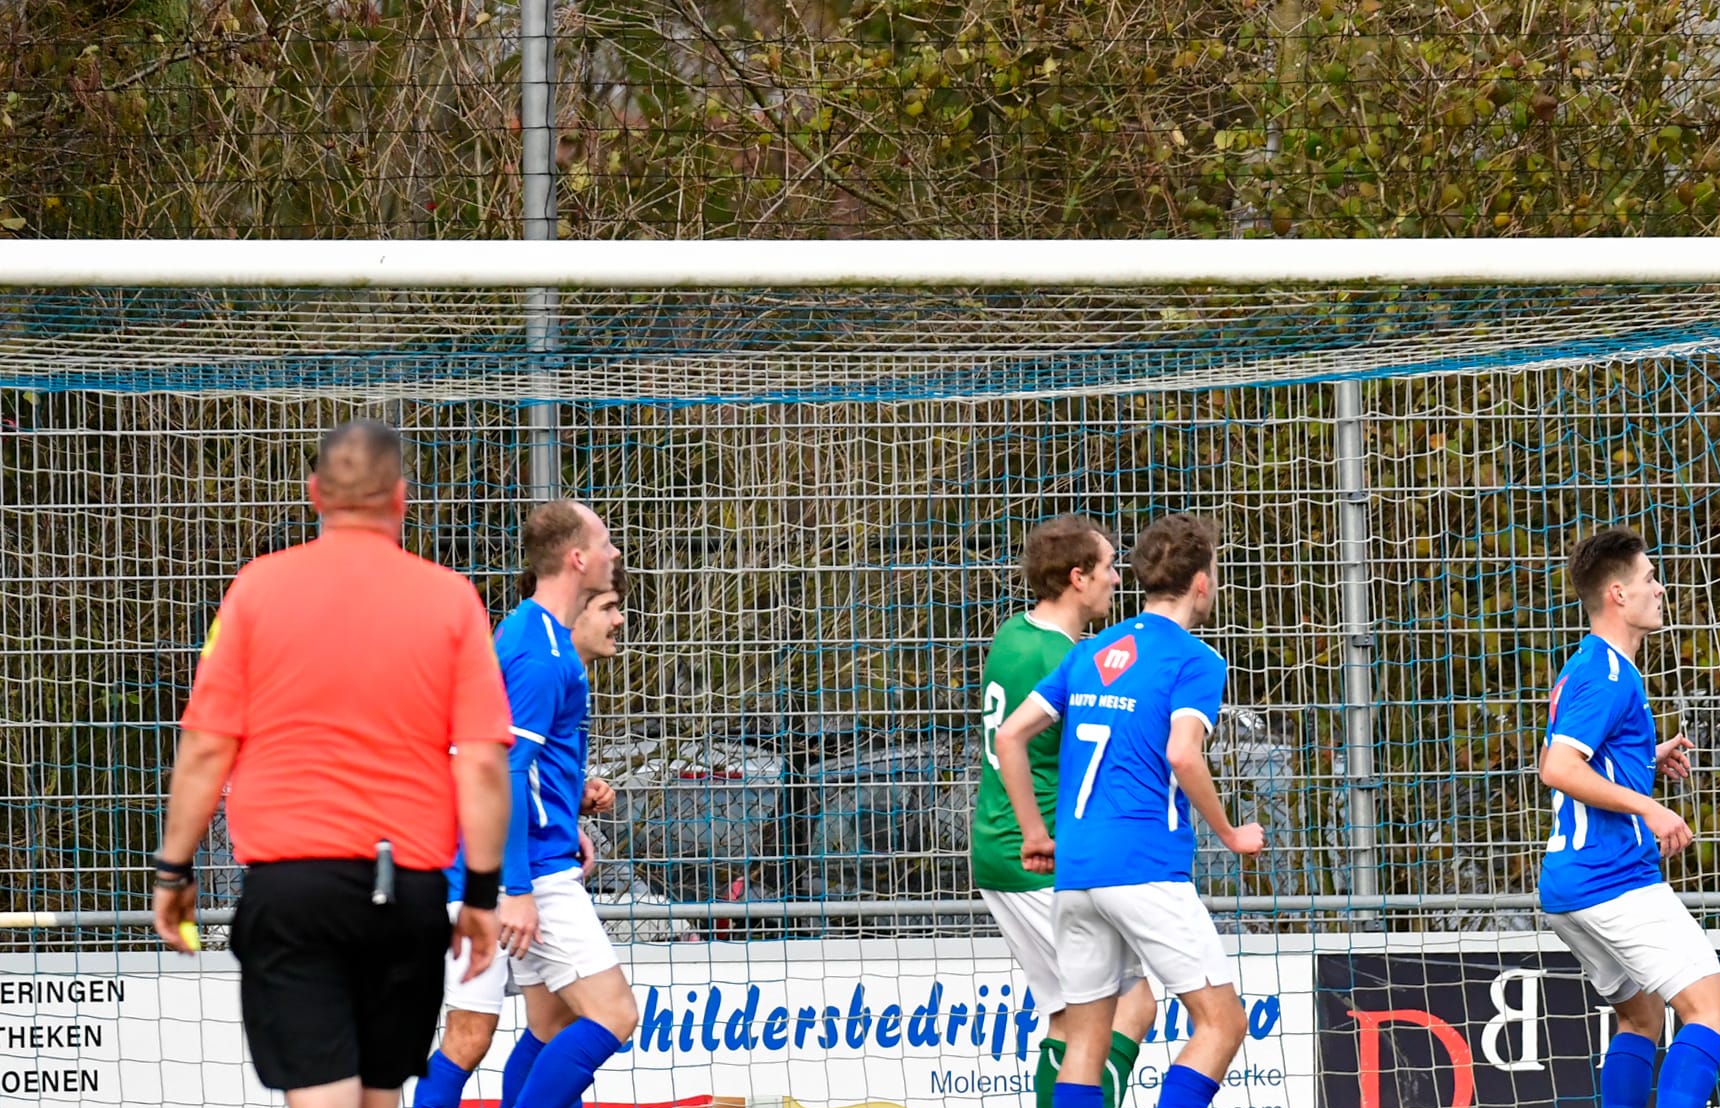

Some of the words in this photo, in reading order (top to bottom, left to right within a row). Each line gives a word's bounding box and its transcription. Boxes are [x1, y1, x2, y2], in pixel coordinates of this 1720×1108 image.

[1069, 693, 1097, 708] AUTO
[1074, 723, 1111, 819] 7
[615, 979, 1038, 1062] hildersbedrijf
[2, 1069, 98, 1093] OENEN
